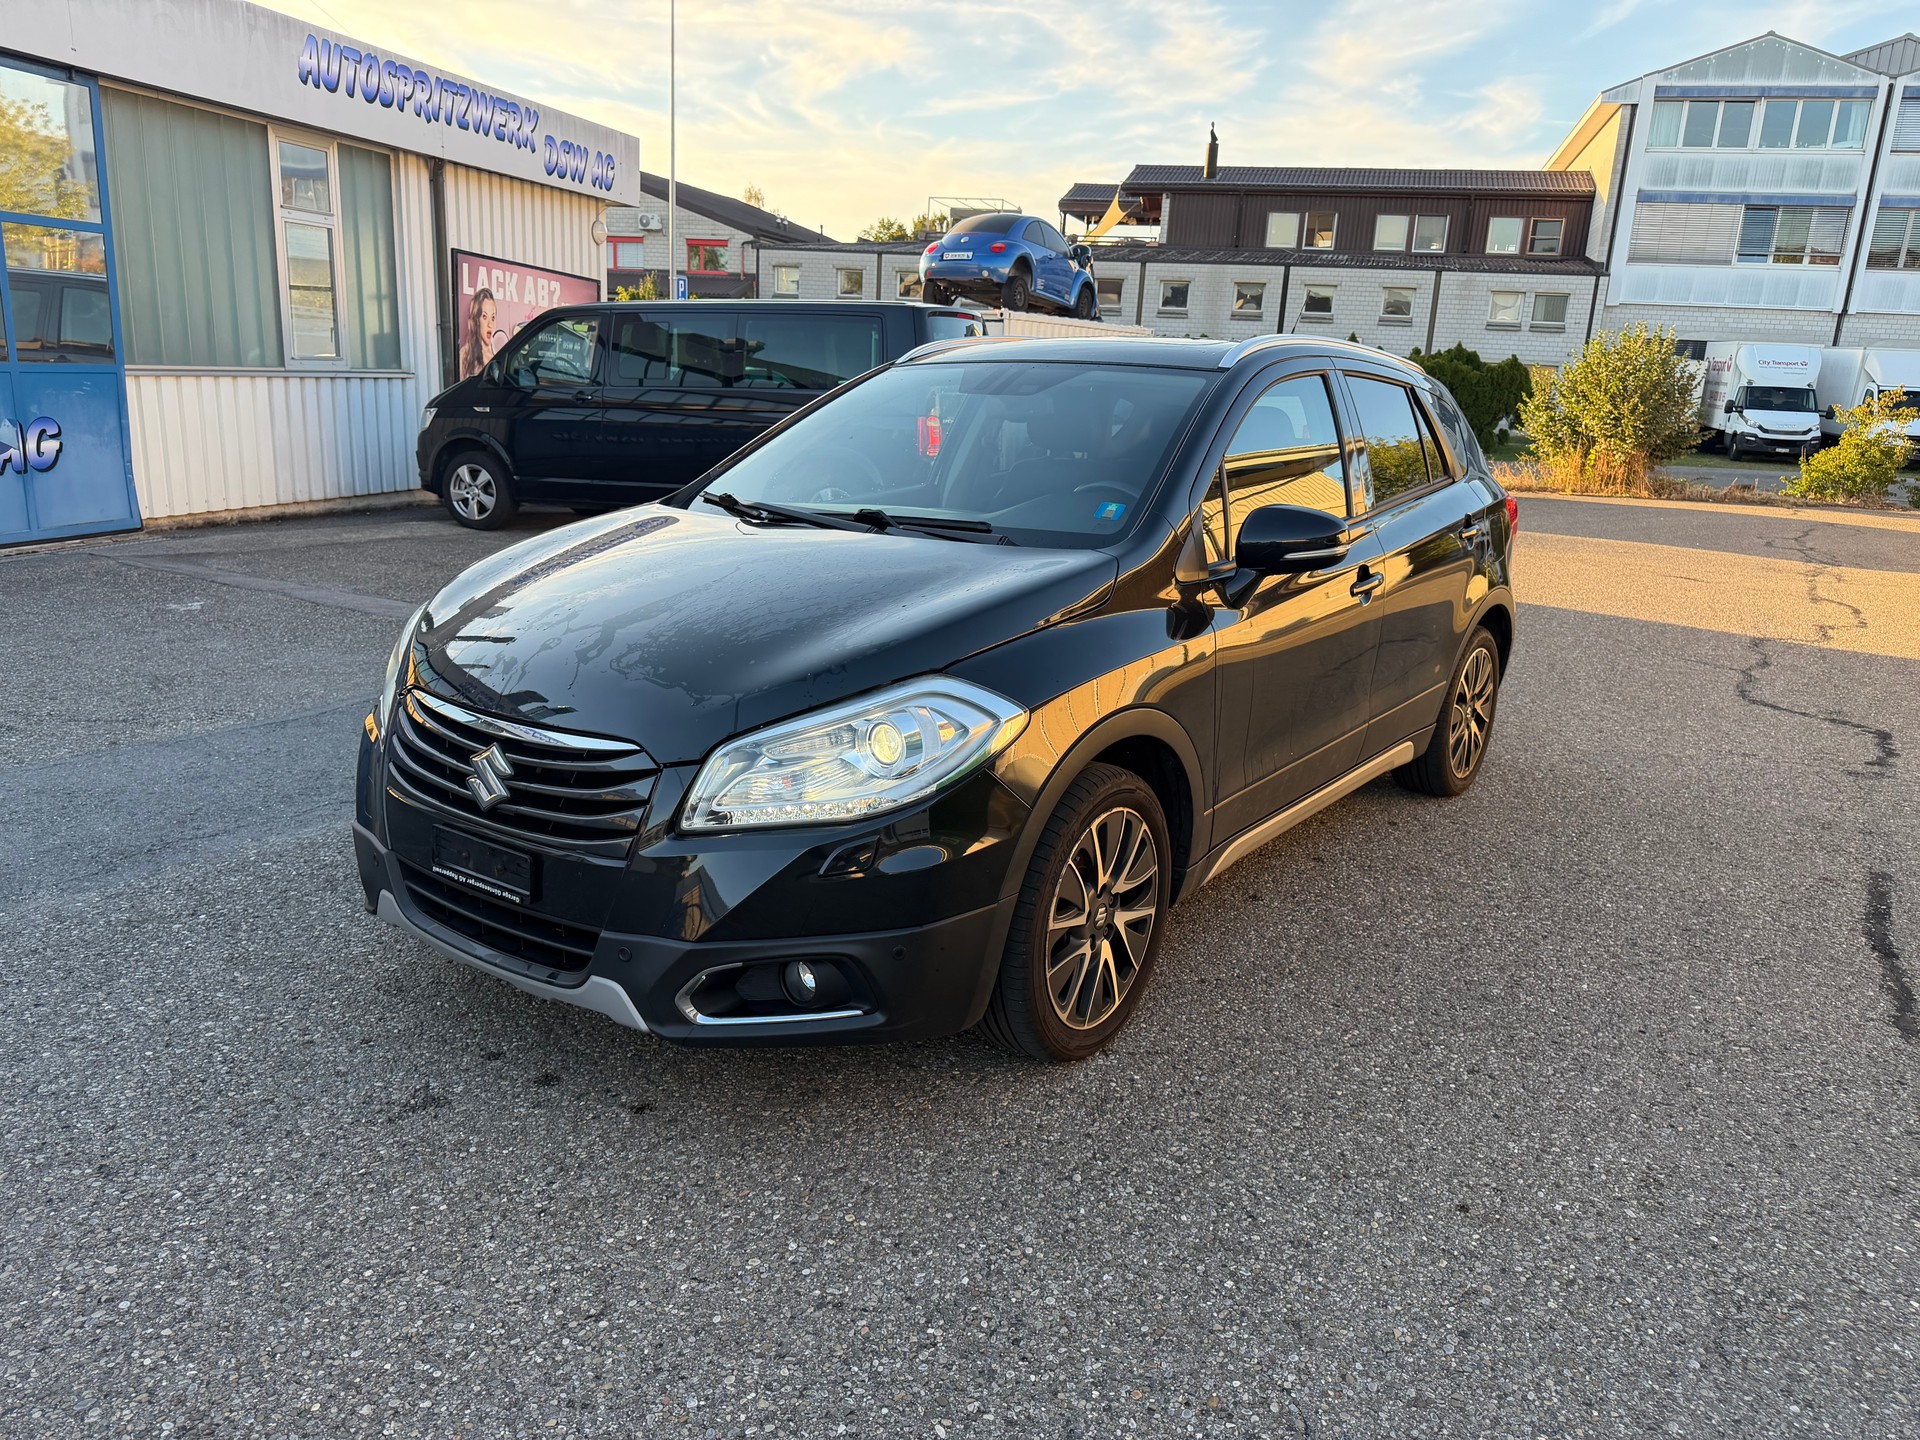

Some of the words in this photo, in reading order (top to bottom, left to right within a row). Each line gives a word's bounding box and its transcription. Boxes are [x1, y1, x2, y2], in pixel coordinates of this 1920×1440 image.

[298, 33, 539, 153] AUTOSPRITZWERK
[543, 134, 589, 184] DSW
[591, 150, 616, 191] AG
[462, 262, 519, 303] LACK
[523, 275, 561, 308] AB?
[678, 280, 685, 297] P
[1771, 359, 1799, 367] Transport
[458, 875, 466, 883] AG
[502, 891, 520, 903] Garage
